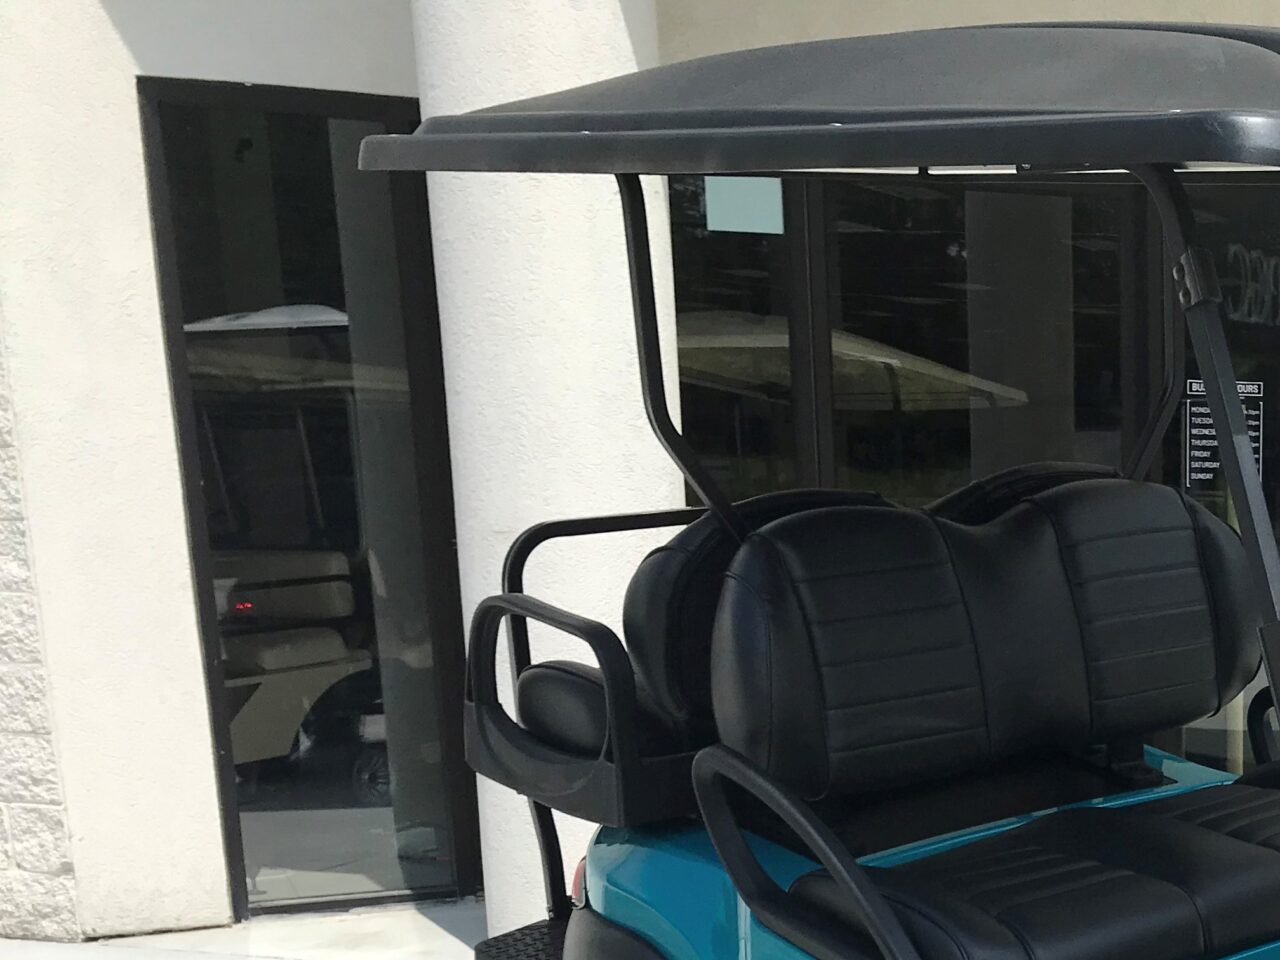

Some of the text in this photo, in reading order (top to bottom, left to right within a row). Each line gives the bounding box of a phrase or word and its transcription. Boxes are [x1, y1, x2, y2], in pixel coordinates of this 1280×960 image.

[1237, 384, 1259, 394] OURS
[1191, 406, 1211, 414] MONDA
[1191, 417, 1214, 425] TUESDA
[1190, 428, 1217, 436] WEDNES
[1191, 439, 1219, 447] THURSDA
[1190, 450, 1211, 458] FRIDAY
[1190, 461, 1220, 469] SATURDAY
[1190, 472, 1213, 480] SUNDAY
